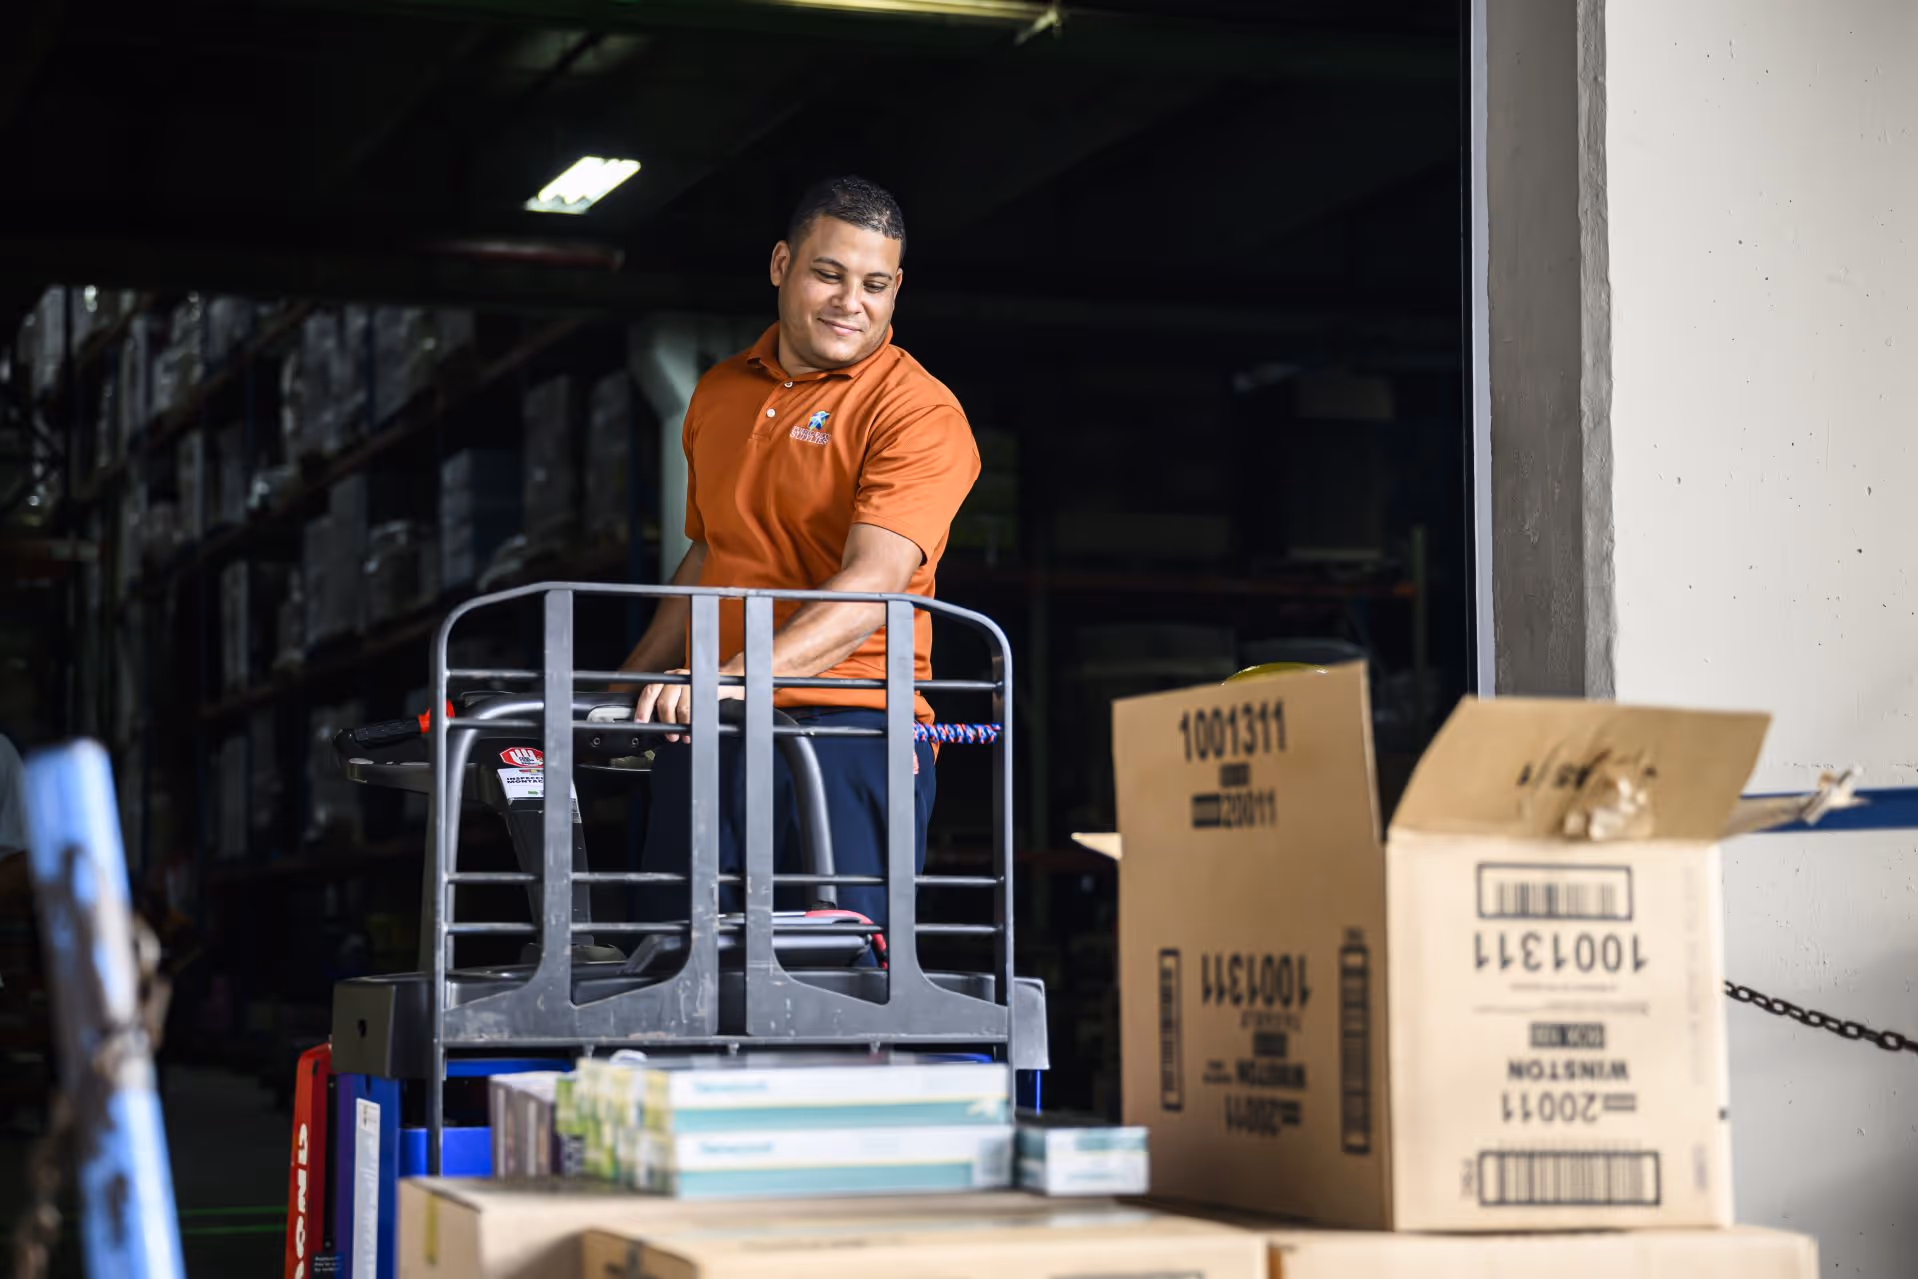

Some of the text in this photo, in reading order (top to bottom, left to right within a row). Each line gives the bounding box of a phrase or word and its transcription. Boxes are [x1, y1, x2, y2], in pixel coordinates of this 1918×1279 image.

[1179, 699, 1286, 761] 1001311
[1474, 933, 1647, 972] 1001311
[1202, 954, 1311, 1009] 1001311
[1508, 1059, 1629, 1081] WINSTON
[1501, 1093, 1597, 1124] 20011
